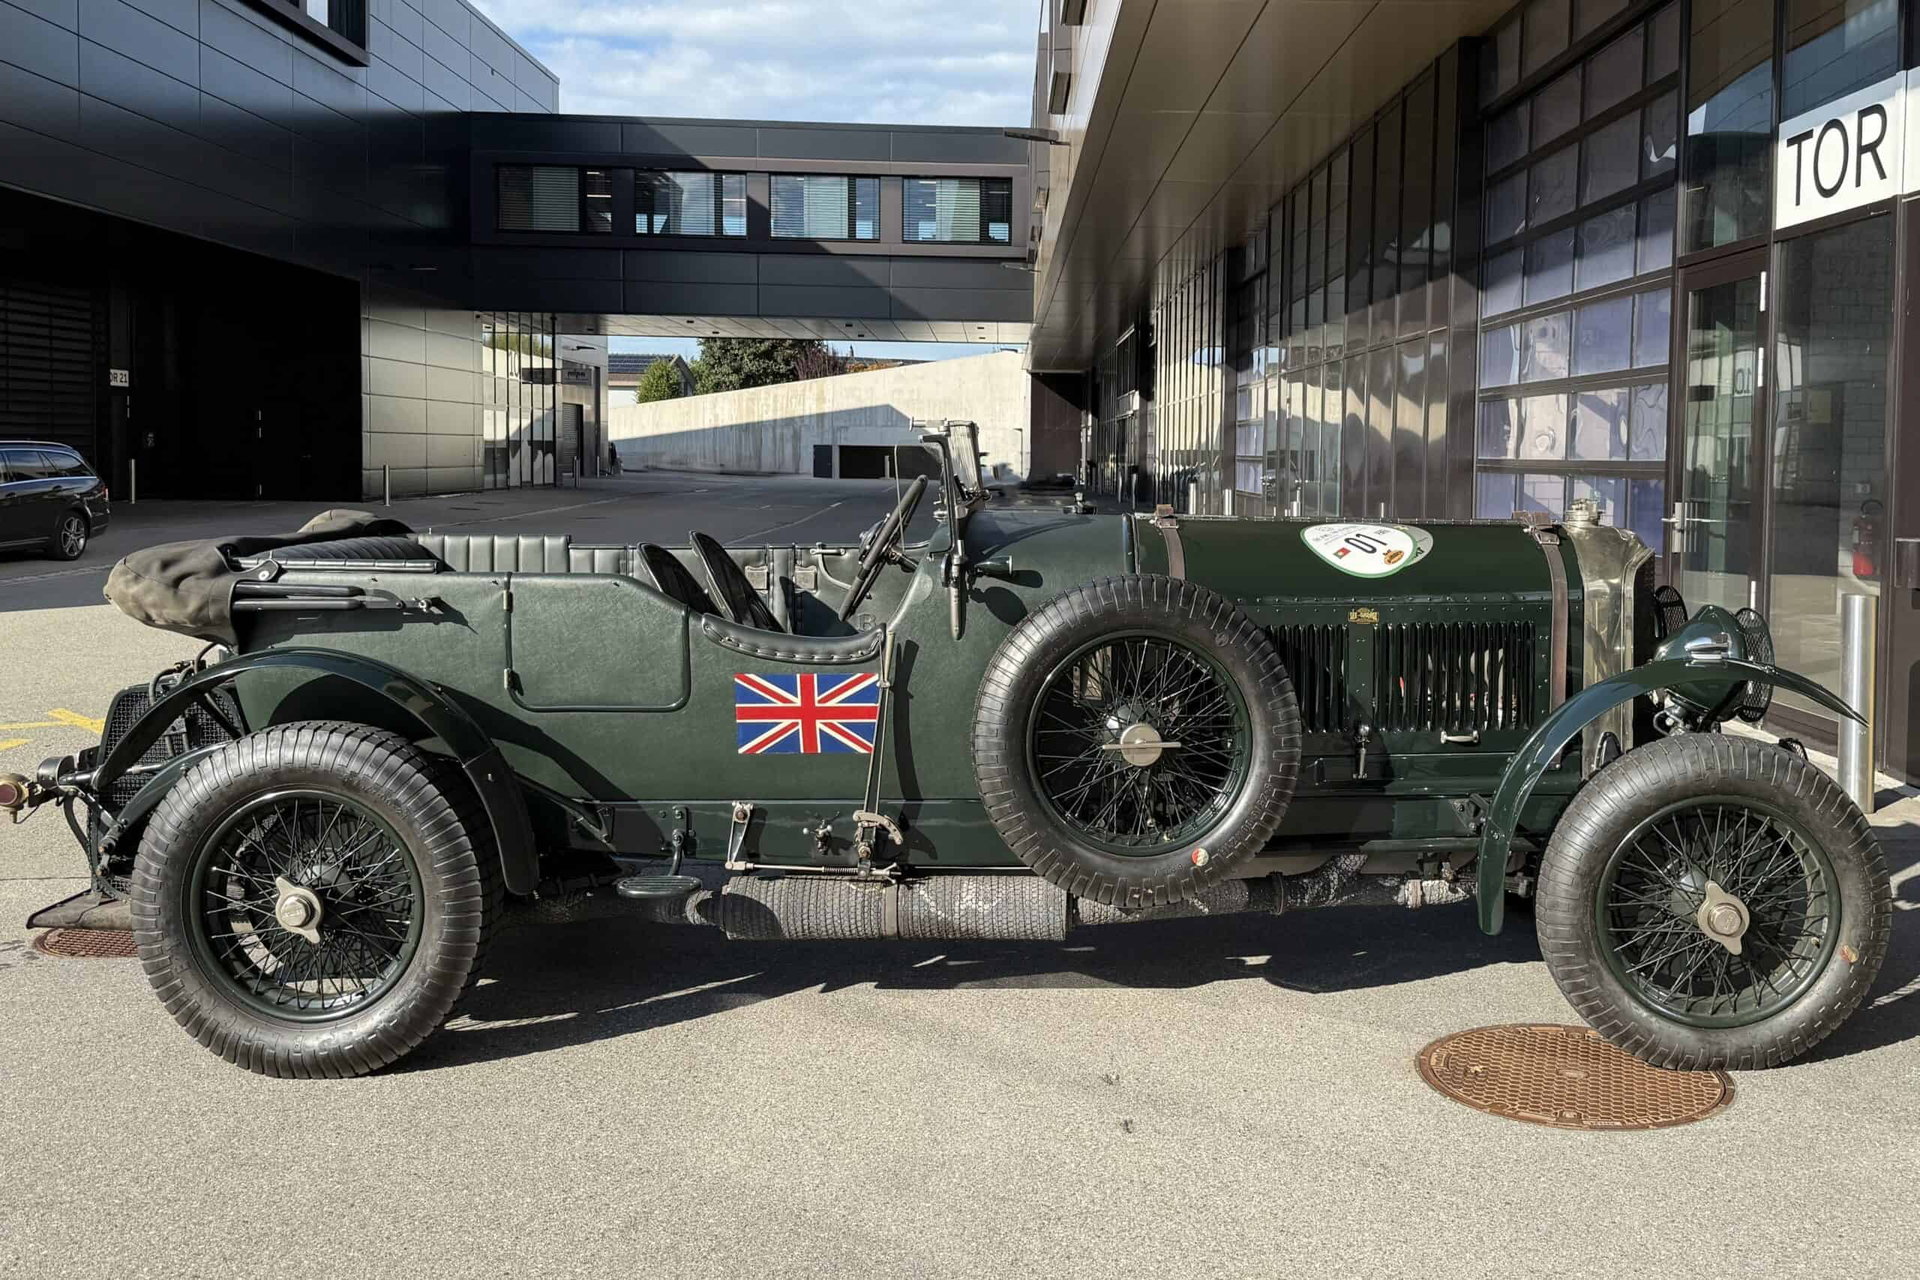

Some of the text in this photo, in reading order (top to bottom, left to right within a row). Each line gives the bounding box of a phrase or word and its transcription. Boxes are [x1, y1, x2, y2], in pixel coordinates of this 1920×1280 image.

[1786, 103, 1888, 207] TOR
[119, 372, 128, 384] 21
[1344, 533, 1388, 554] 01
